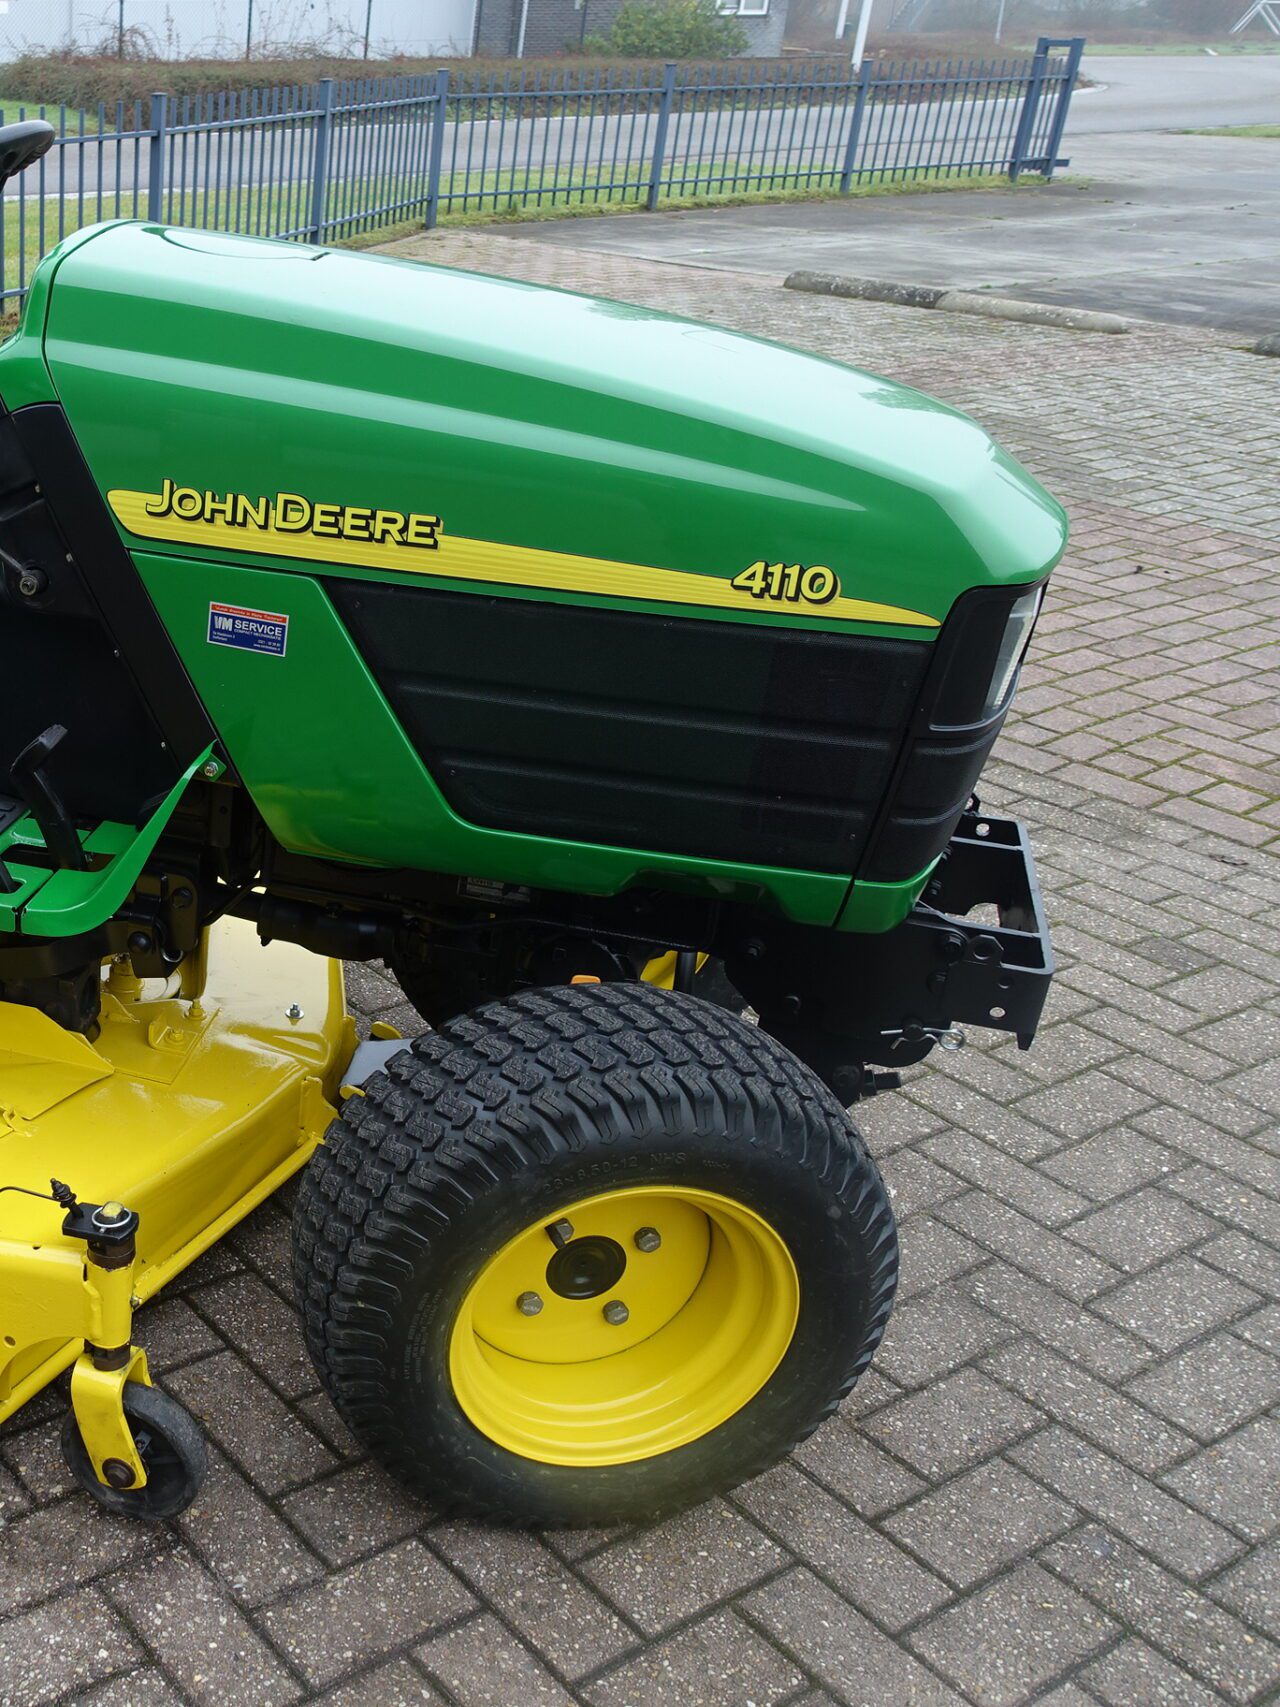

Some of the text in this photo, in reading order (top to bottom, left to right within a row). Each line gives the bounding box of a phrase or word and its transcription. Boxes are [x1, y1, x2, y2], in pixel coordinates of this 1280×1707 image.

[146, 478, 439, 550] JOHN DEERE
[731, 560, 839, 605] 4110
[234, 619, 283, 637] SERVICE
